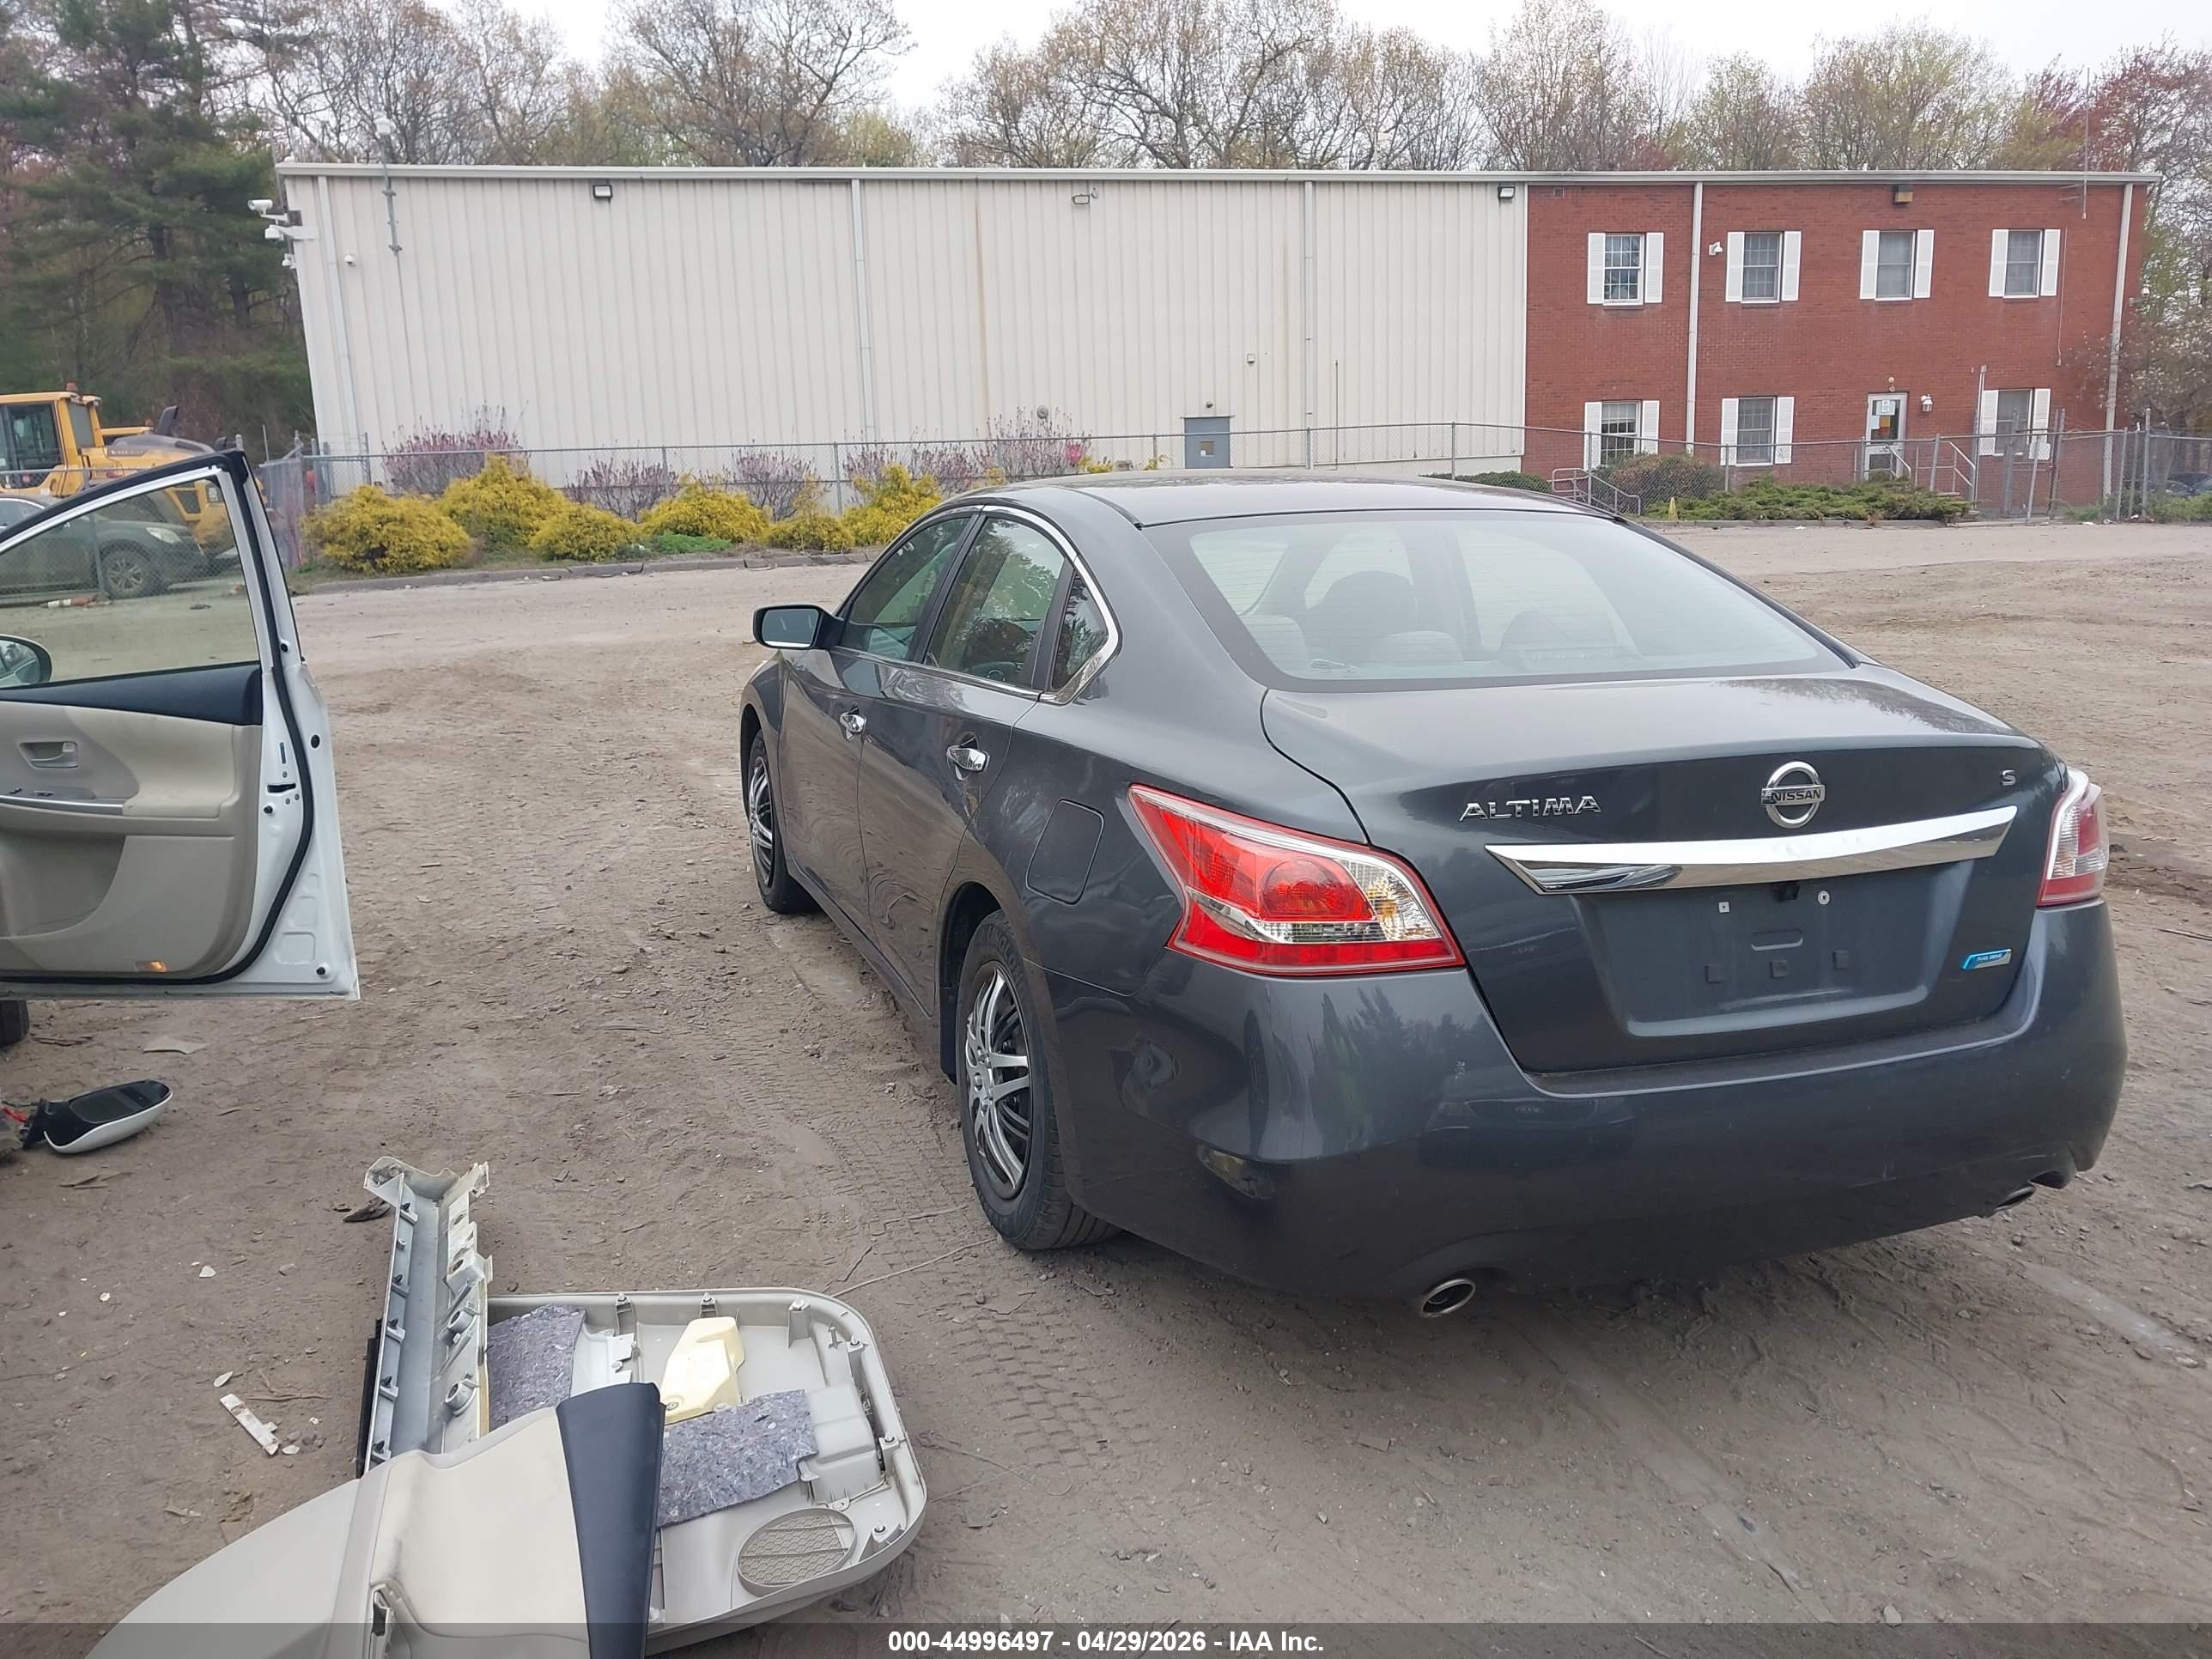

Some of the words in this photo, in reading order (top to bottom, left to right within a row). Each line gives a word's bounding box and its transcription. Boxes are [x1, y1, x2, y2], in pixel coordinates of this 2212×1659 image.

[2002, 769, 2016, 787] S
[1771, 789, 1822, 802] NISSAN
[1459, 795, 1602, 822] ALTIMA
